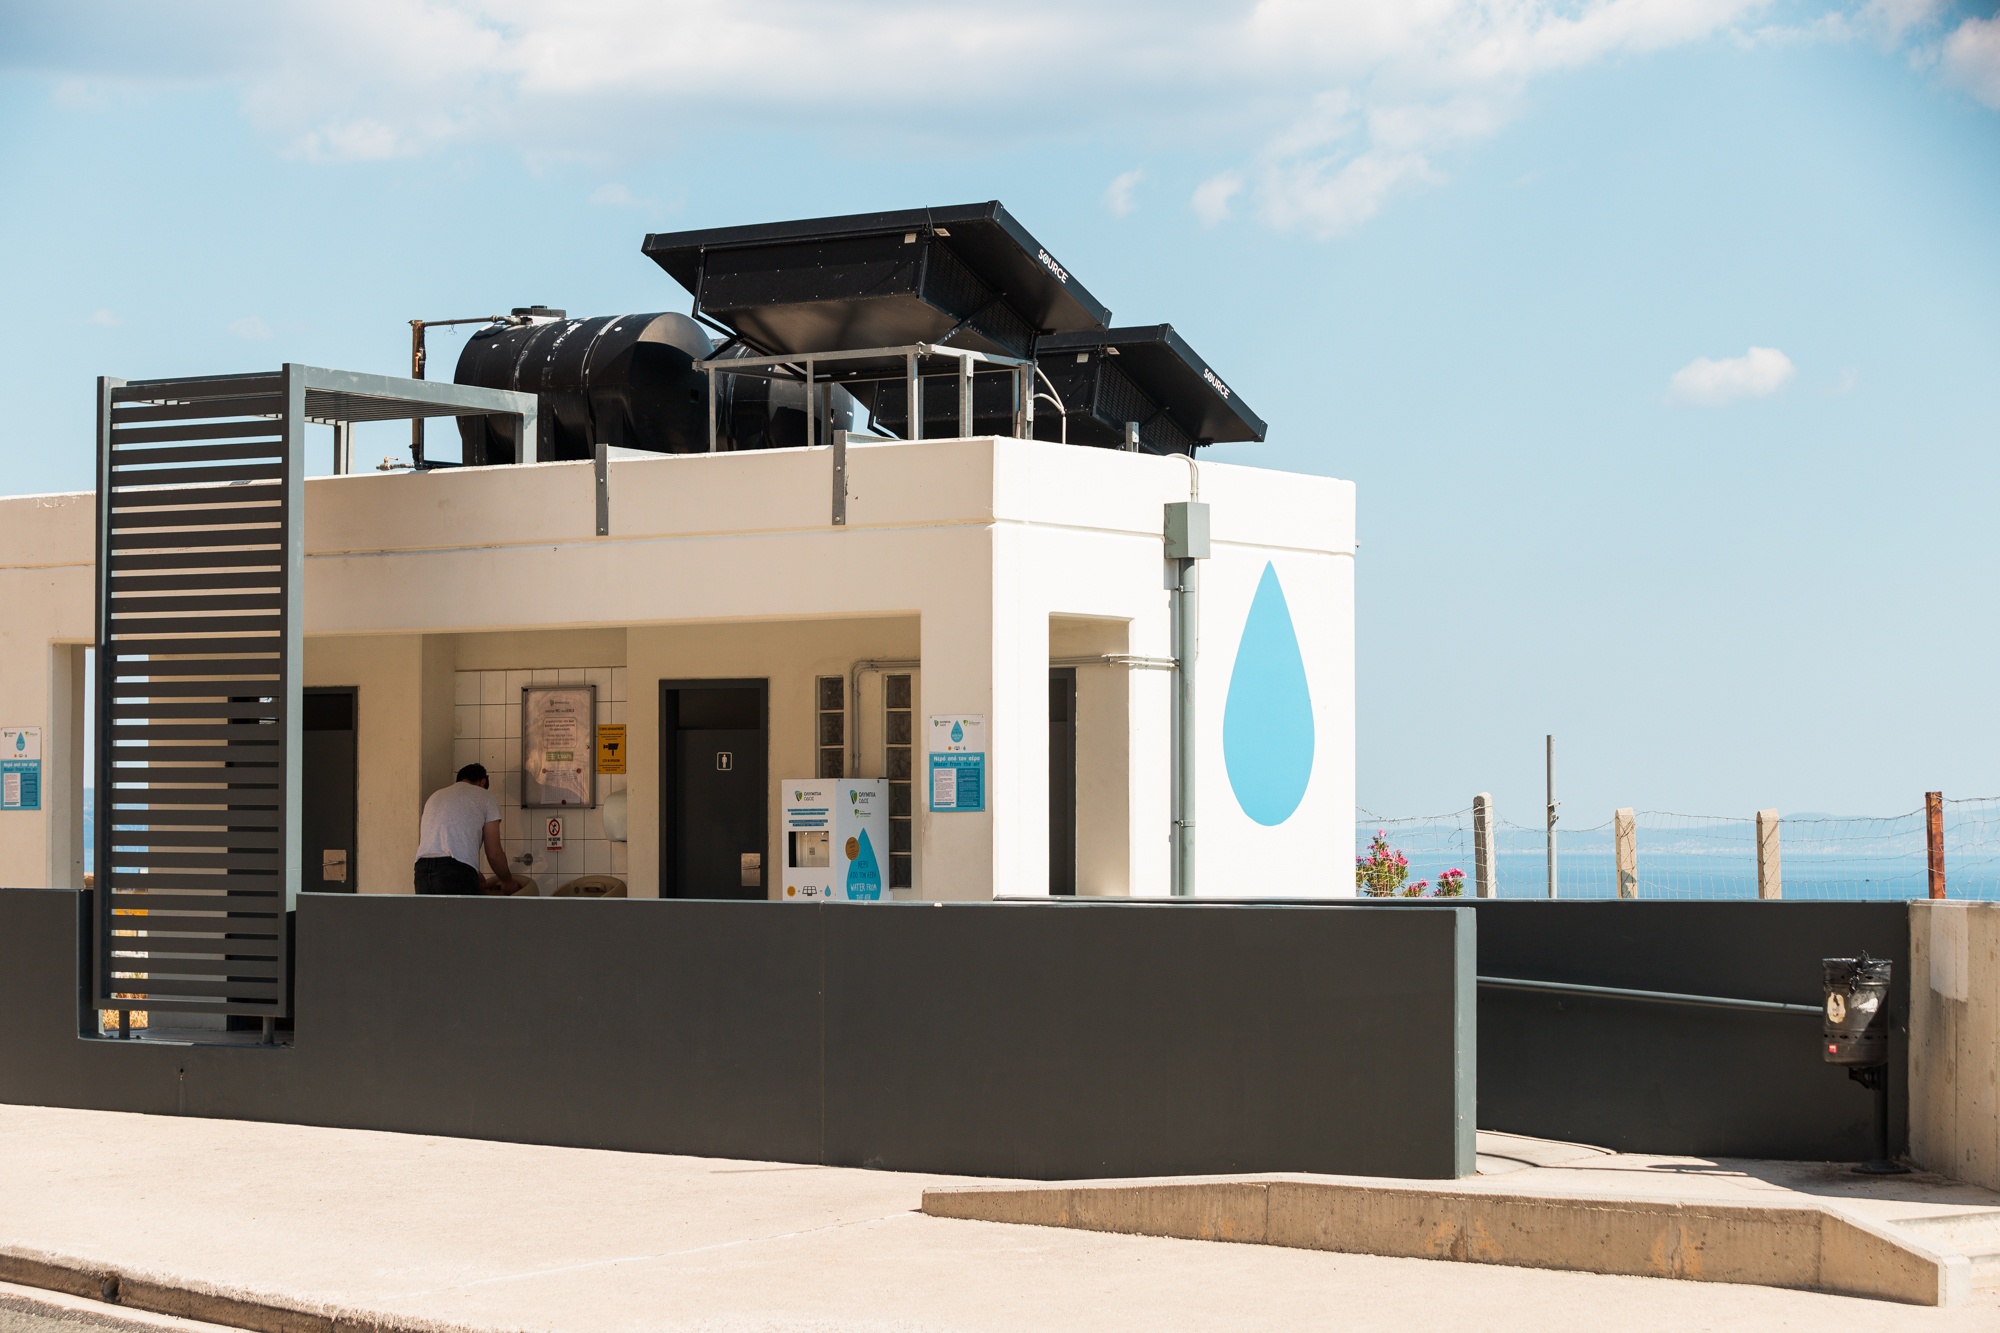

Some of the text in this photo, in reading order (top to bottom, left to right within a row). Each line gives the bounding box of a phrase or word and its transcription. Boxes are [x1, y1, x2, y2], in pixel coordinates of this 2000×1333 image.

[1038, 249, 1068, 284] SOURCE
[1204, 368, 1230, 399] SOURCE
[850, 883, 865, 891] WATER
